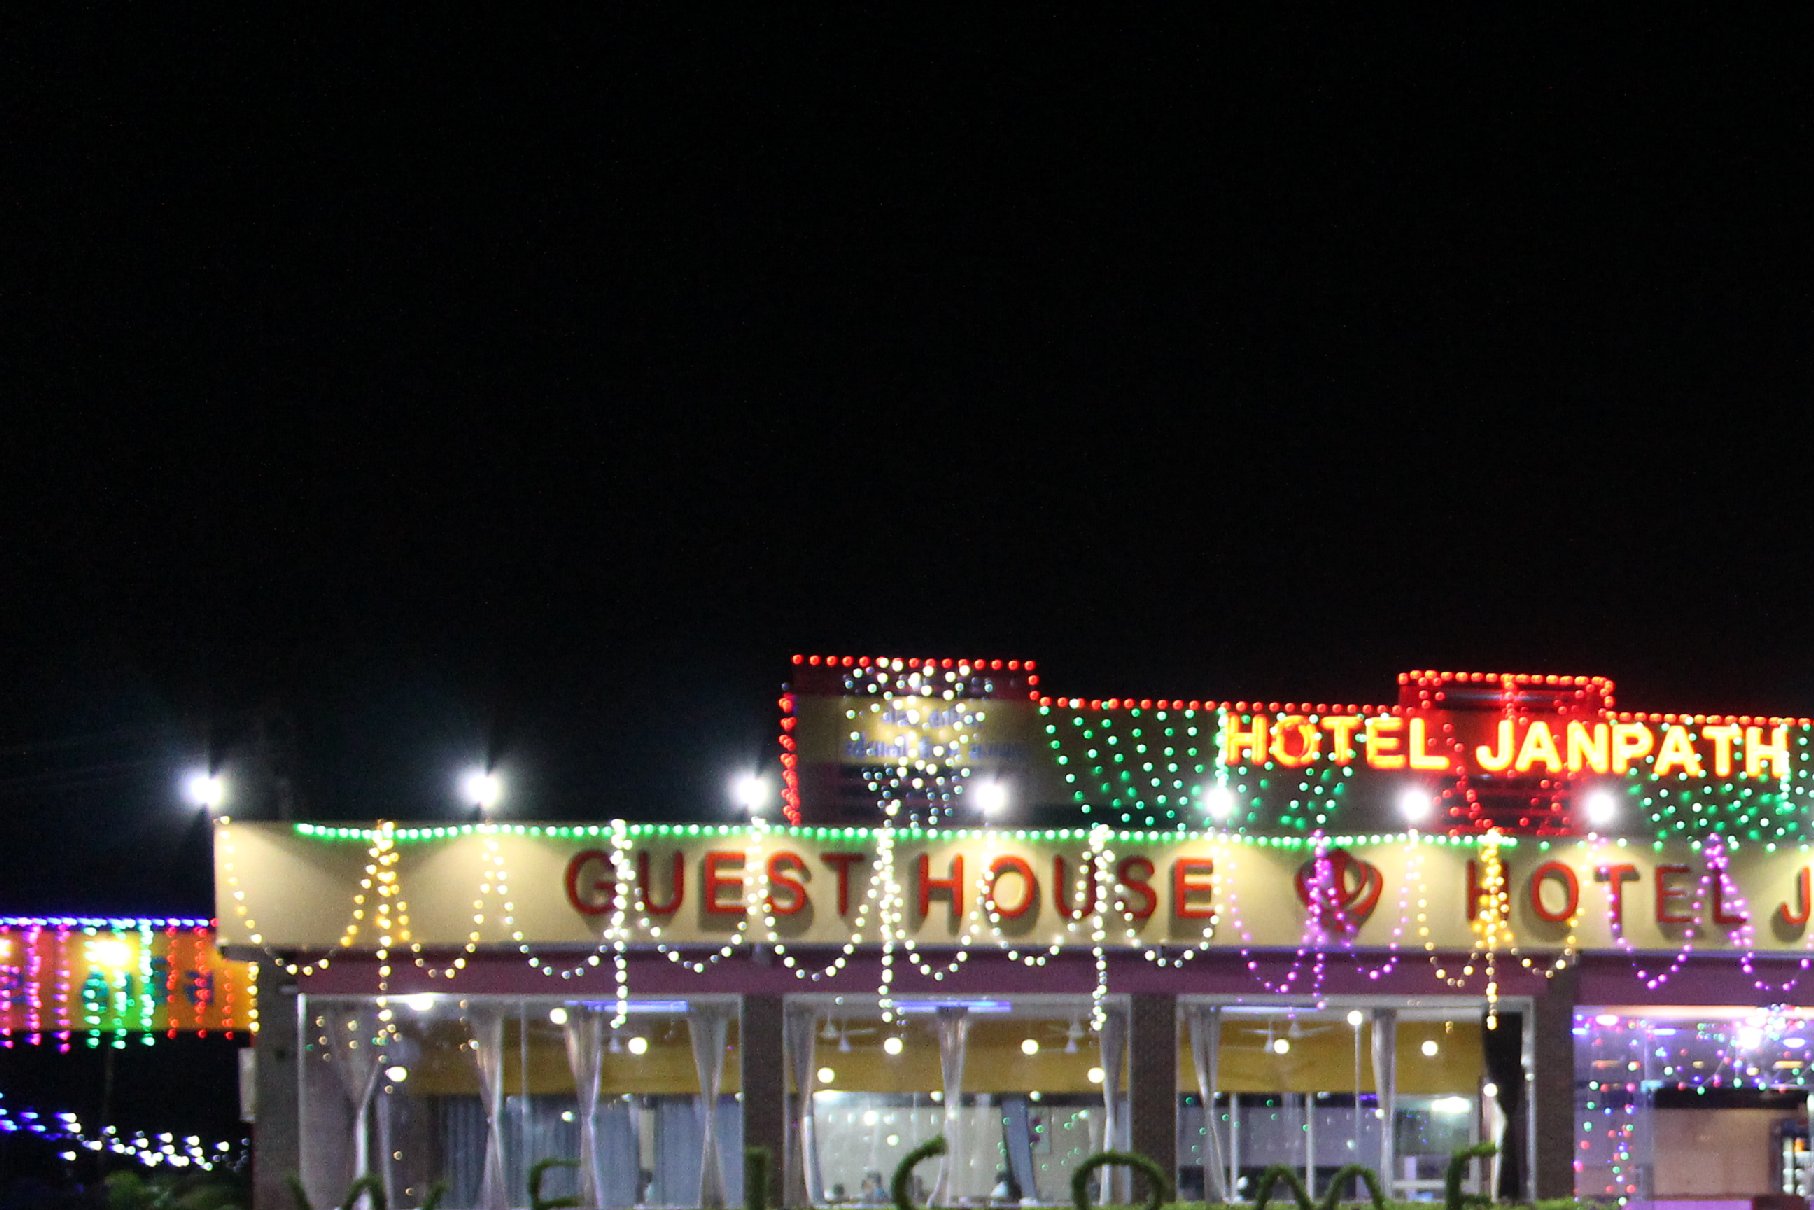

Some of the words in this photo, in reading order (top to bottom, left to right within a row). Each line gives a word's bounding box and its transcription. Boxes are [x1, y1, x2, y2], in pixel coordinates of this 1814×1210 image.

[1222, 714, 1449, 770] HOTEL
[1475, 719, 1788, 777] JANPATH
[564, 849, 866, 918] GUEST
[919, 853, 1218, 920] HOUSE
[1466, 859, 1752, 925] HOTEL
